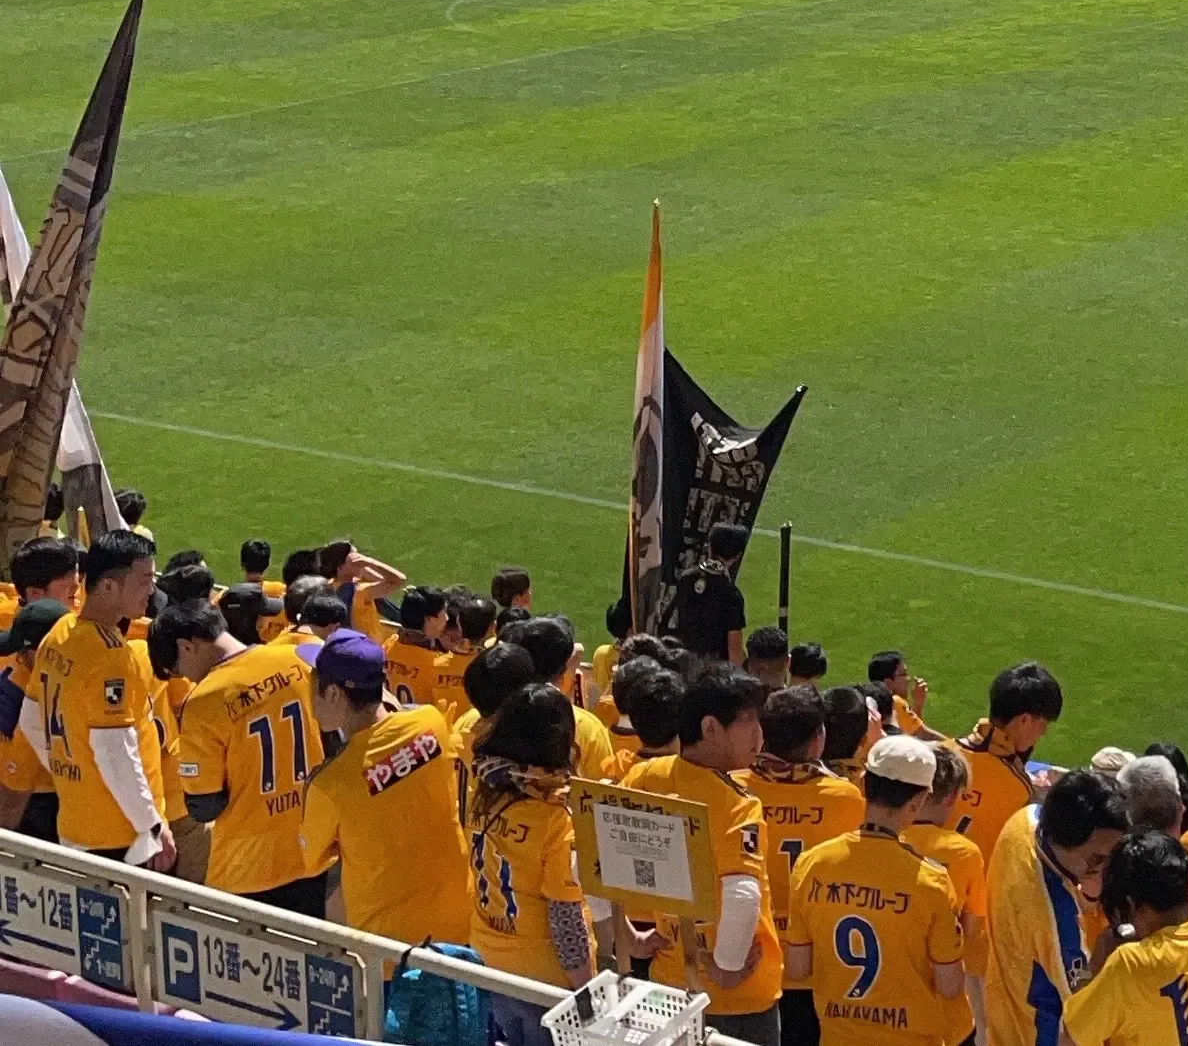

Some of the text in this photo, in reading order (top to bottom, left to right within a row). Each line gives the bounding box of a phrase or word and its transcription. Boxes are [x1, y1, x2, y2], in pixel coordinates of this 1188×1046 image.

[248, 699, 308, 795] 11
[367, 734, 438, 792] やまや
[266, 790, 301, 817] YUTA
[168, 936, 195, 985] P
[834, 914, 882, 1000] 9
[825, 1002, 909, 1029] NAKAYAMA
